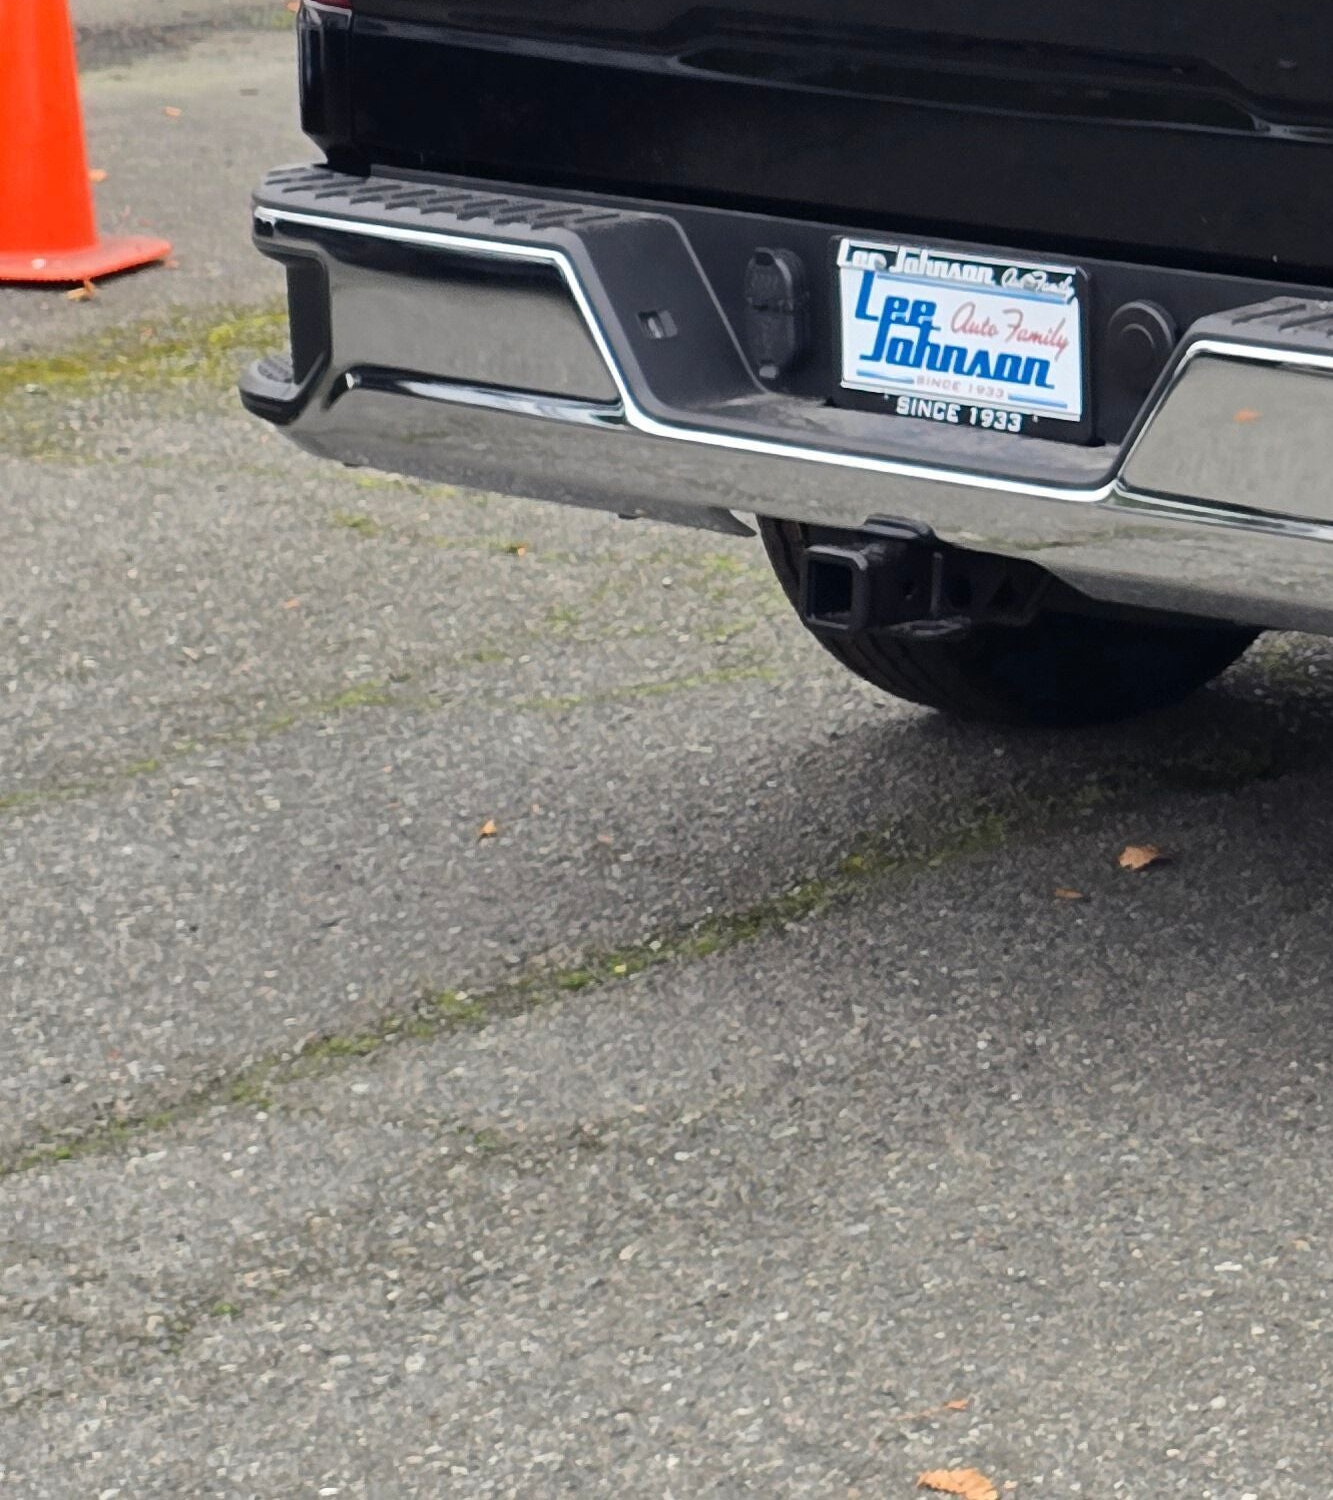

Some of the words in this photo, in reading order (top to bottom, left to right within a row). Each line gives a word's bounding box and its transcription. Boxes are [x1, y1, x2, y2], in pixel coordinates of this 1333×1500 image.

[889, 245, 995, 285] Johnson
[855, 270, 941, 330] Lee
[859, 320, 1054, 389] Johnson
[950, 302, 999, 338] Auto
[1003, 308, 1070, 362] Family
[916, 374, 961, 393] SINCE
[968, 383, 1006, 398] 1933
[896, 395, 960, 423] SINCE
[969, 407, 1022, 433] 1933
